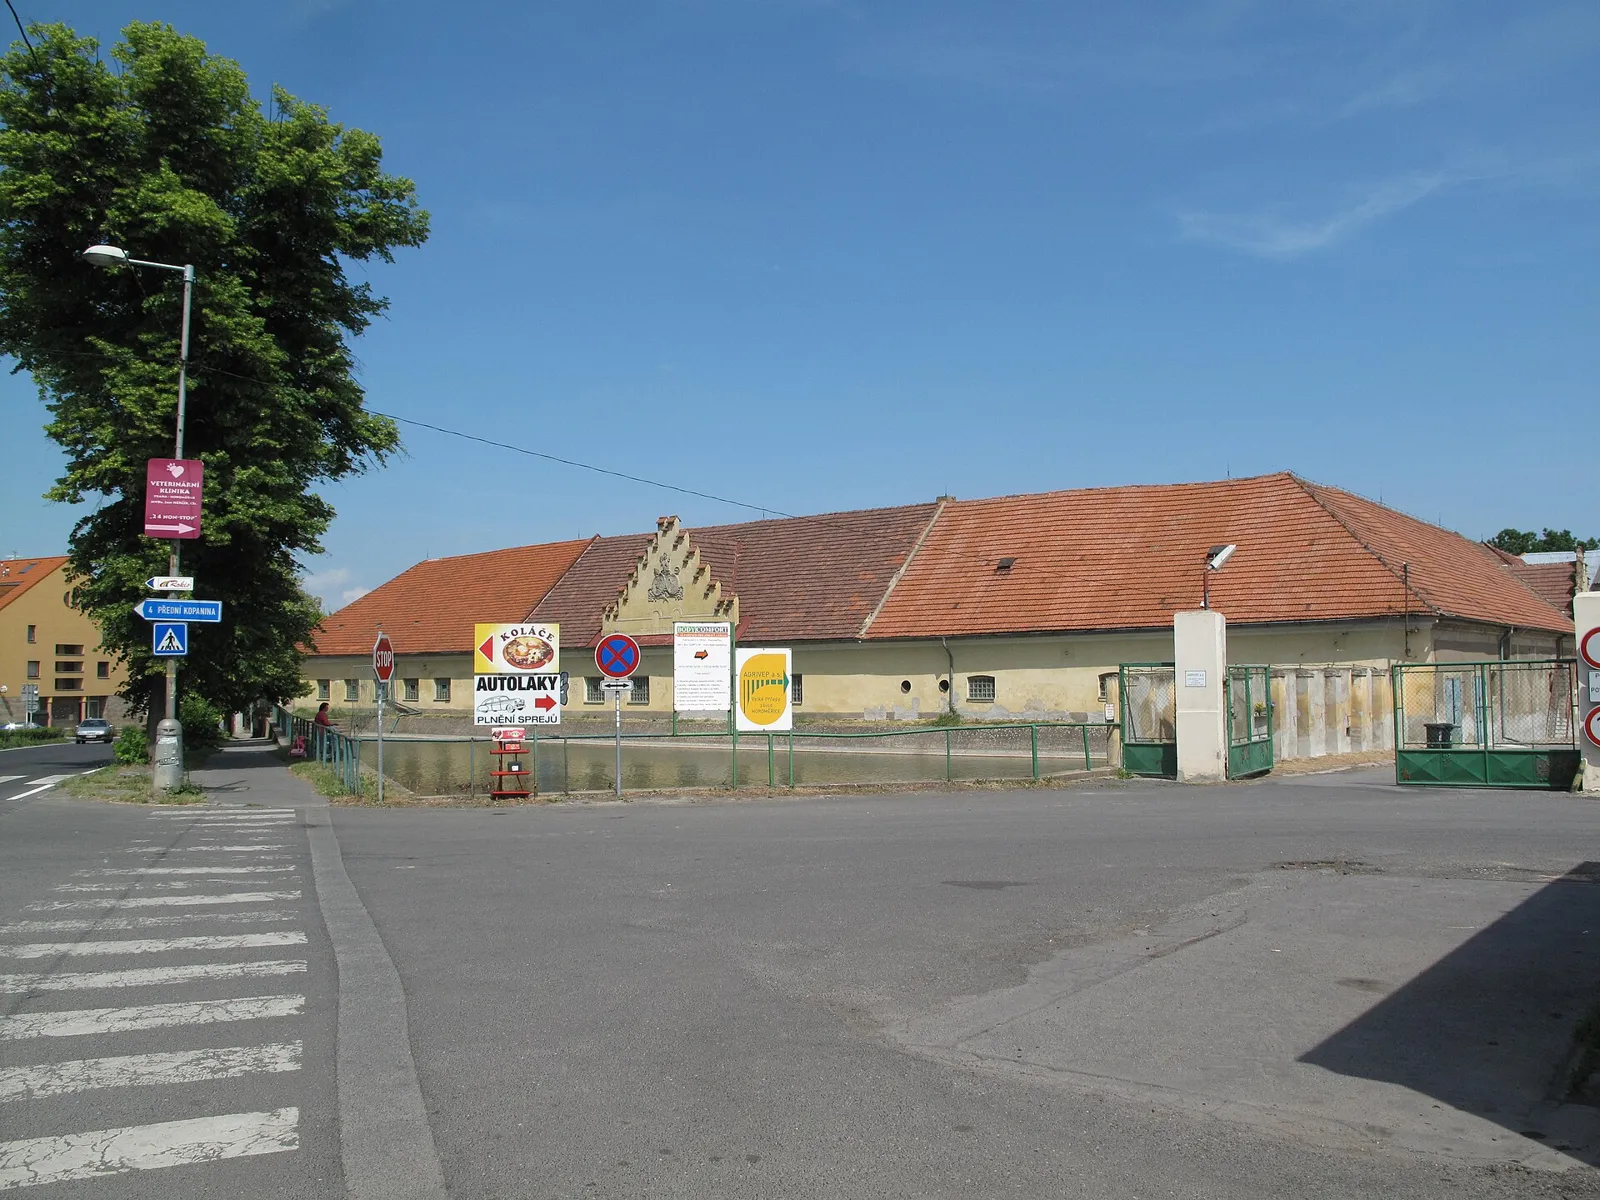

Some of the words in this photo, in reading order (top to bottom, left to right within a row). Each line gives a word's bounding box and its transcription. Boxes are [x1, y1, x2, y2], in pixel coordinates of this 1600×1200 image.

[150, 480, 200, 488] VETERINÁRNÍ
[148, 606, 153, 614] 4
[157, 604, 182, 614] PŘEDNÍ
[183, 607, 216, 616] KOPANINA
[500, 625, 555, 642] KOLÁČE
[376, 650, 392, 667] STOP
[476, 676, 558, 691] AUTOLAKY
[477, 713, 515, 724] PLNĚNÍ
[518, 713, 558, 724] SPREJŮ
